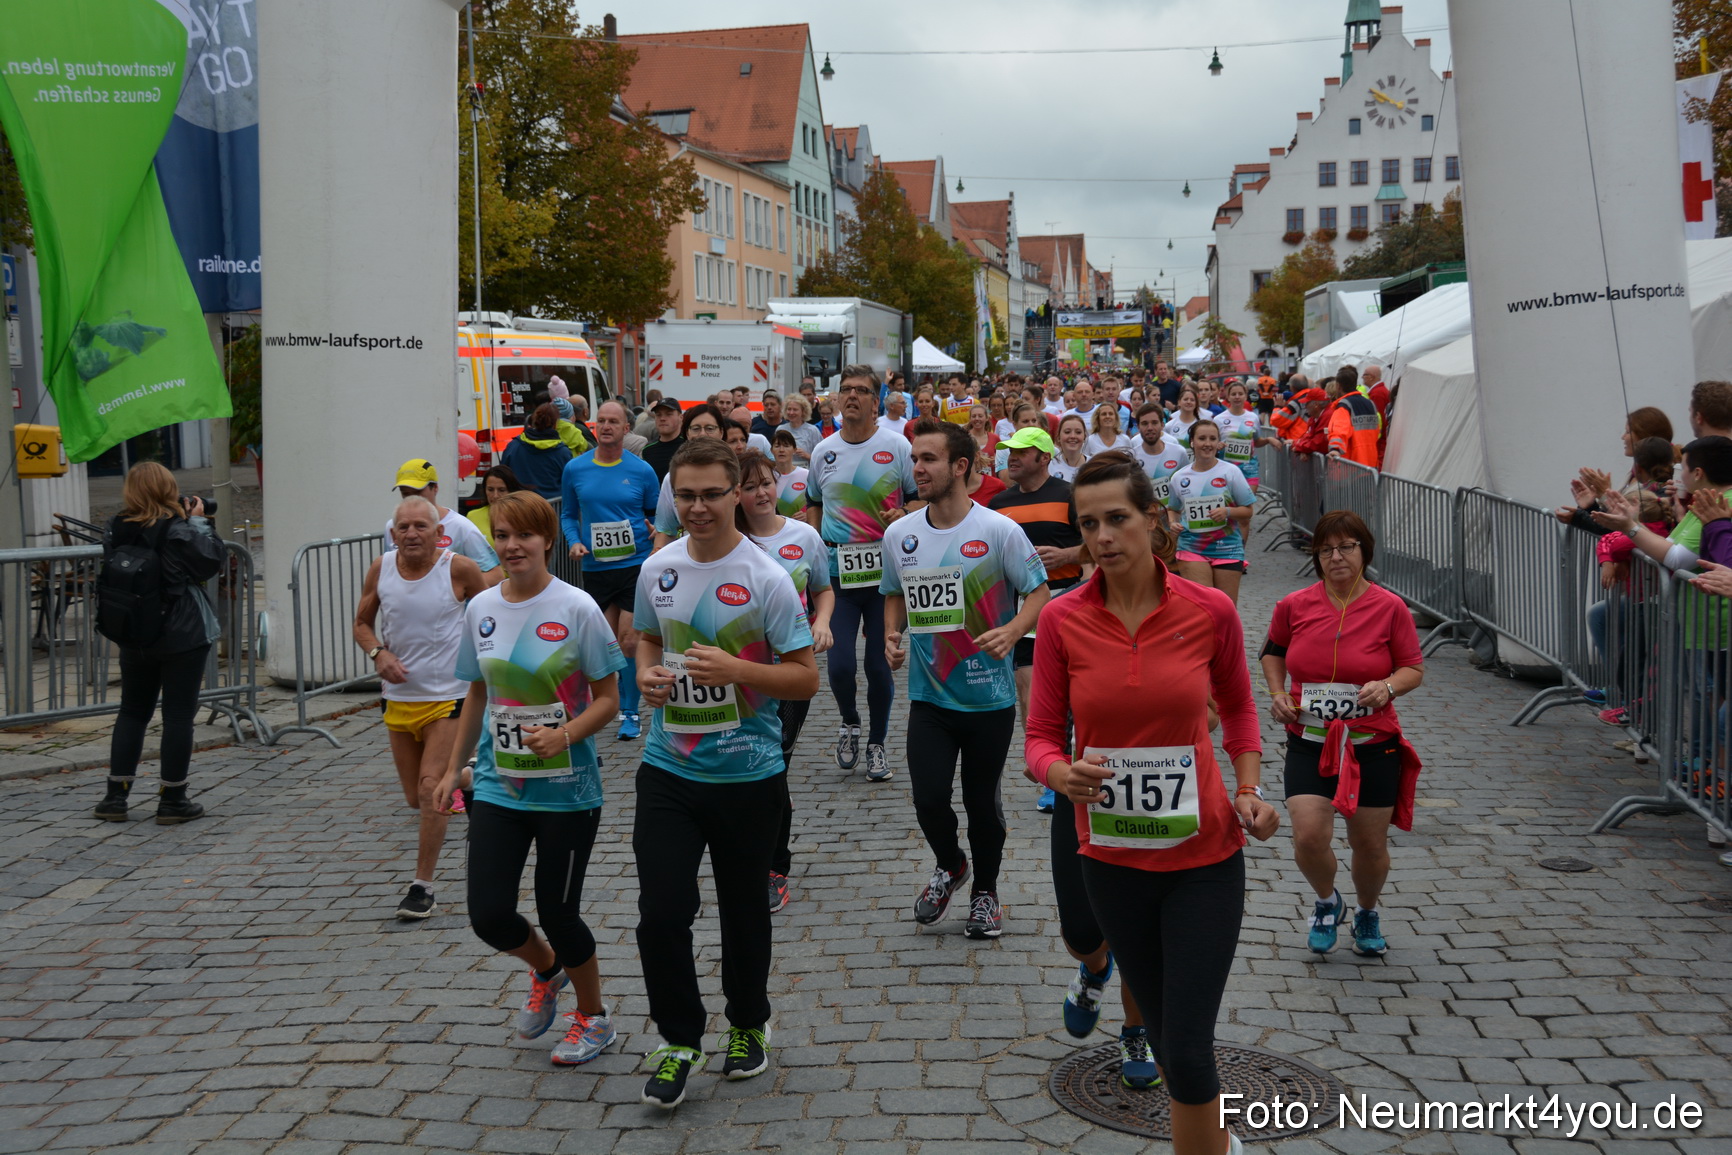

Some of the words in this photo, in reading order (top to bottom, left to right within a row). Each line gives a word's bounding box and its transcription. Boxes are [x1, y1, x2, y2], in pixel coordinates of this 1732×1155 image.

[198, 46, 253, 95] GO
[1507, 282, 1685, 313] www.bmw-laufsport.de
[265, 333, 423, 350] www.bmw-laufsport.de
[1228, 444, 1249, 454] 5078
[596, 530, 630, 547] 5316
[782, 548, 801, 556] Hervis
[964, 545, 985, 554] Hervis
[844, 552, 882, 570] 5191
[919, 574, 950, 582] Neumarkt
[720, 588, 748, 600] Hervis
[908, 582, 958, 610] 5025
[916, 614, 952, 624] Alexander
[540, 626, 566, 636] Hervis
[665, 660, 680, 670] PARTL
[966, 658, 982, 670] 16.
[491, 711, 512, 720] PARTL
[671, 710, 726, 722] Maximilian
[1310, 700, 1368, 721] 5325
[496, 722, 559, 750] 51
[716, 734, 758, 746] Neumarkter
[718, 743, 754, 754] Stadtlauf
[514, 758, 544, 768] Sarah
[1122, 758, 1175, 768] Neumarkt
[1099, 773, 1186, 811] 5157
[1115, 820, 1169, 835] Claudia
